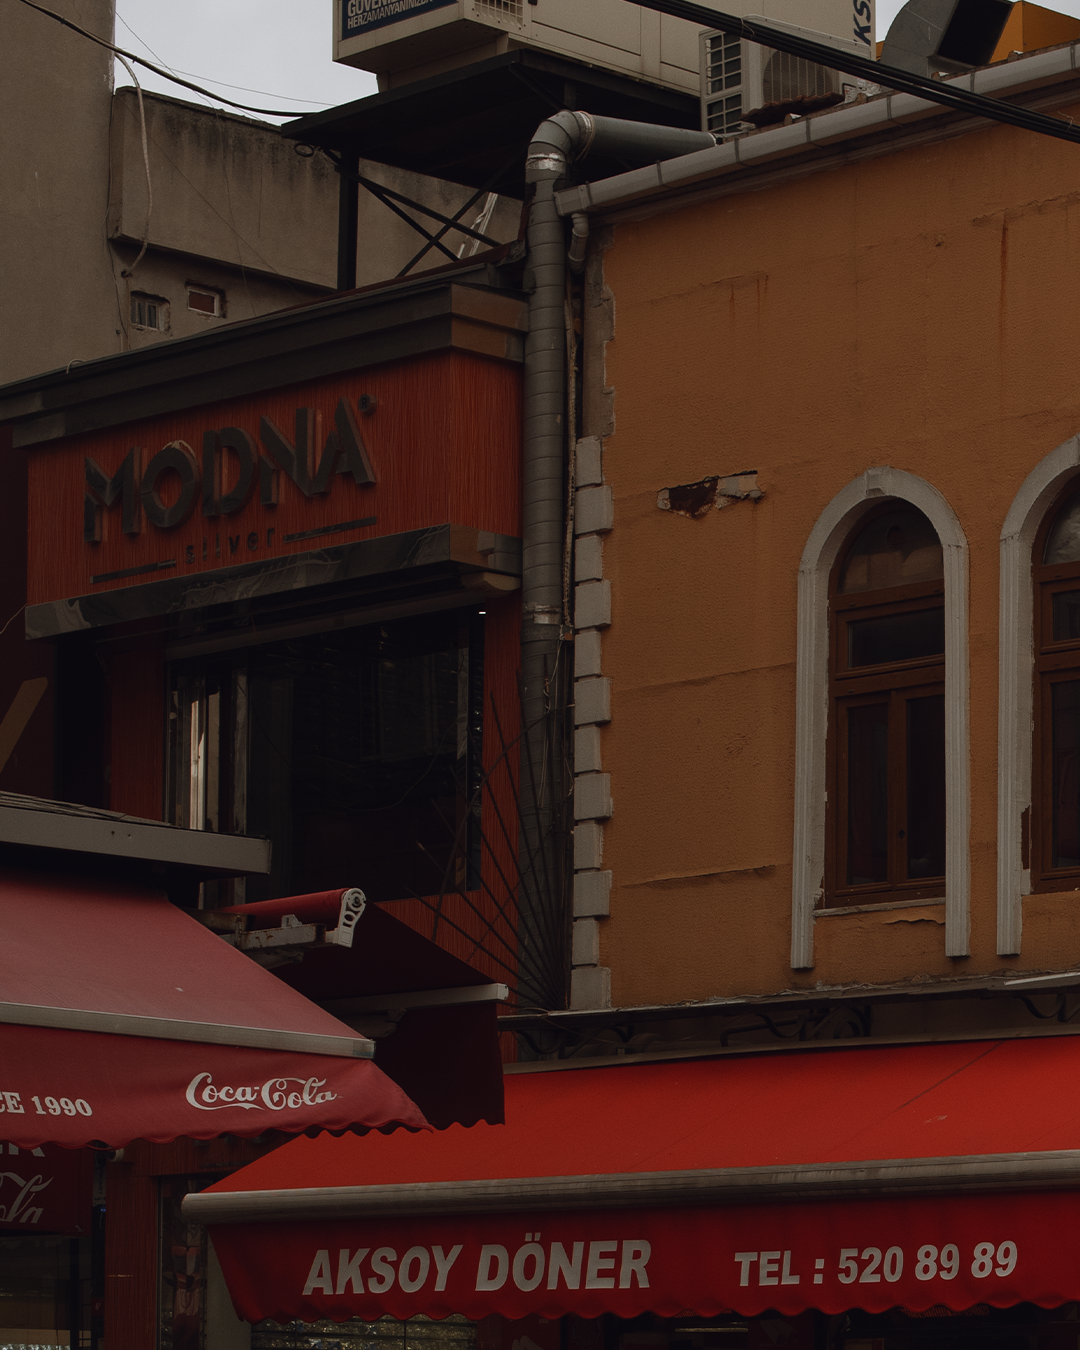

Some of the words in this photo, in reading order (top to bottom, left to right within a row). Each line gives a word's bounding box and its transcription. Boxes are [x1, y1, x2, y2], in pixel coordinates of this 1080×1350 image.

[83, 397, 377, 544] MODNA
[185, 527, 275, 564] silver
[31, 1096, 93, 1117] 1990
[186, 1072, 338, 1111] Coca-Cola
[302, 1244, 463, 1295] AKSOY
[475, 1232, 652, 1292] DÖNER
[734, 1250, 800, 1287] TEL
[837, 1246, 904, 1284] 520
[914, 1243, 960, 1281] 89
[970, 1240, 1018, 1279] 89
